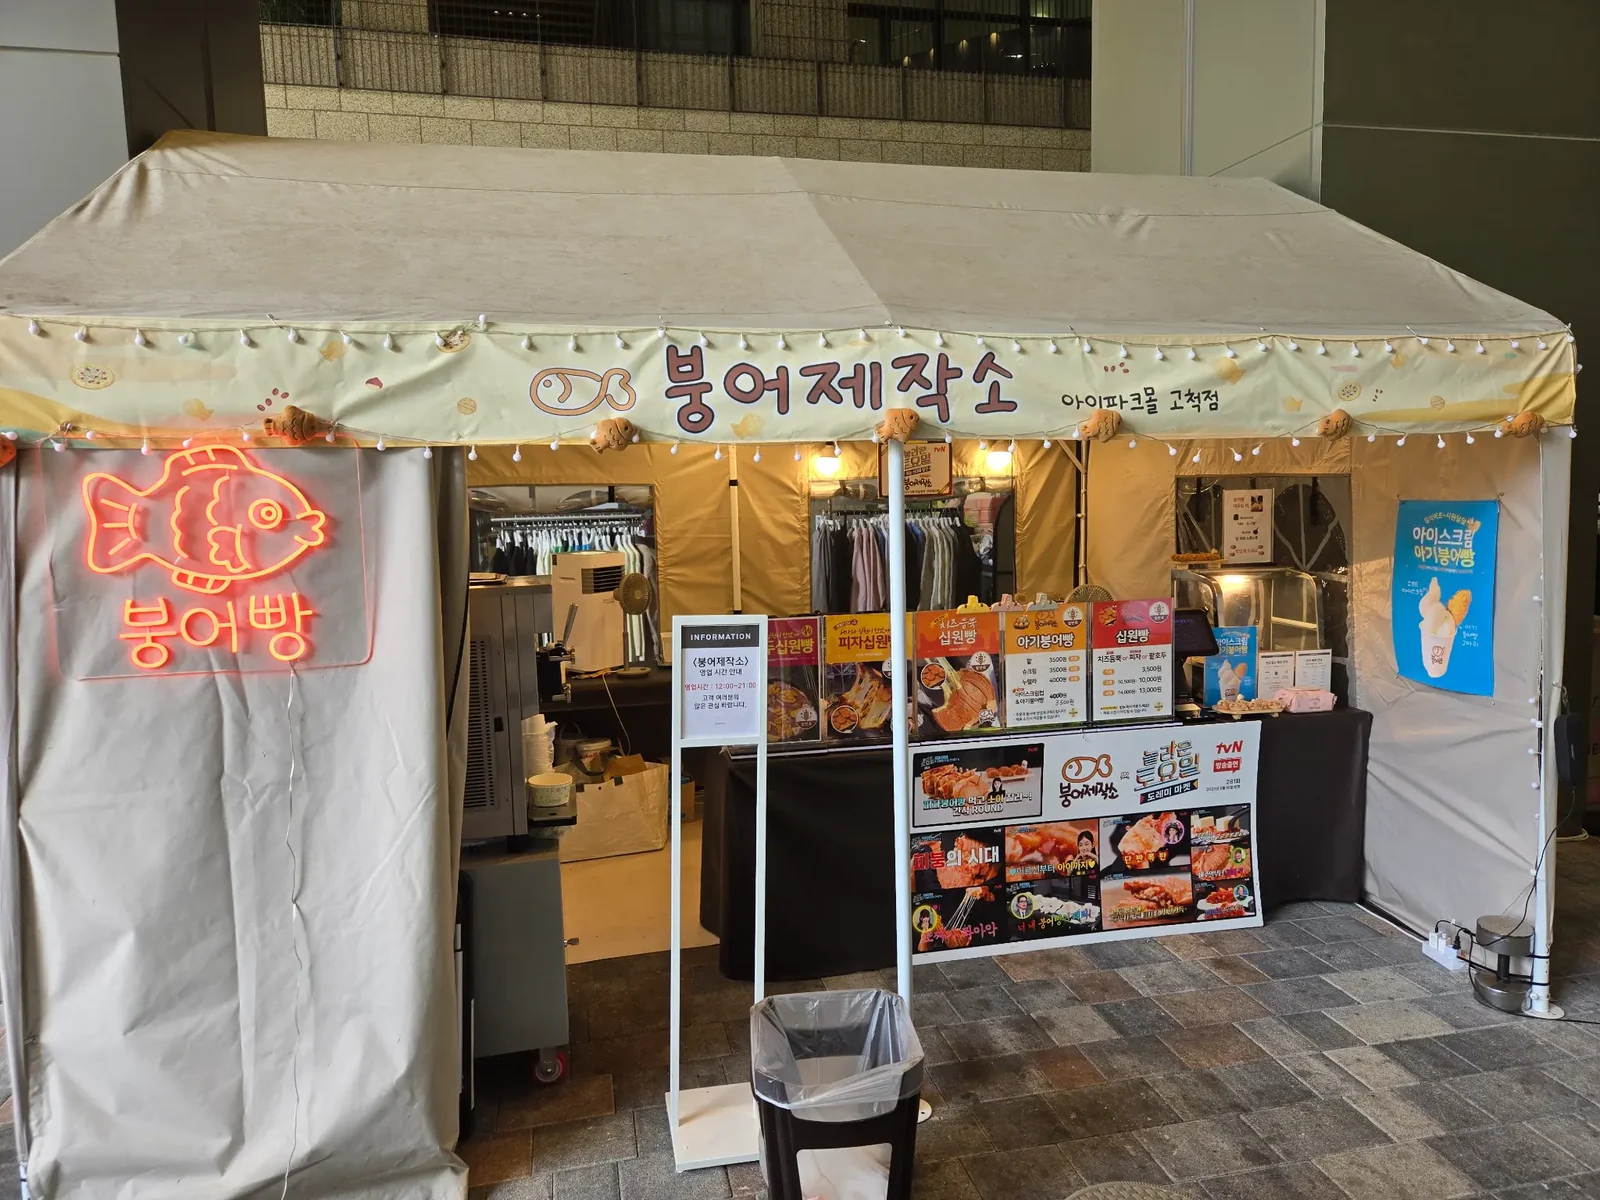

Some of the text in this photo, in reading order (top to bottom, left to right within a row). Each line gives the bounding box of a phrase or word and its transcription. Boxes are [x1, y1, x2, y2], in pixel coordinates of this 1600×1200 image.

[665, 344, 1018, 433] 붕어제작소
[1061, 386, 1219, 415] 아이파크몰 고척점
[1413, 526, 1476, 548] 아이스크림
[1414, 545, 1475, 567] 아기붕어빵
[119, 591, 313, 669] 붕어빵
[690, 633, 752, 641] INFORMATION
[939, 629, 978, 646] 십원빵
[1115, 628, 1150, 644] 십원빵
[838, 634, 891, 650] 피자십원
[1017, 633, 1075, 649] 아기붕어빵
[699, 668, 743, 676] 영업 시간 안내
[1141, 665, 1162, 673] 3,500원
[684, 682, 709, 691] 영업시간
[715, 682, 757, 690] 12:00~21:00
[1139, 686, 1162, 694] 13,000원
[702, 694, 714, 702] 고객
[707, 702, 720, 710] 관심
[1143, 740, 1193, 766] 놀라운
[1216, 740, 1244, 754] tvN
[1134, 753, 1201, 791] 토요일
[1215, 759, 1239, 770] 방송출연
[1059, 782, 1119, 808] 붕어제작소
[1146, 782, 1191, 802] 도레미 마켓
[968, 796, 986, 805] 먹고
[953, 804, 1003, 816] 간식 ROUND
[968, 845, 1000, 864] 시대
[1057, 861, 1089, 873] 아이까지
